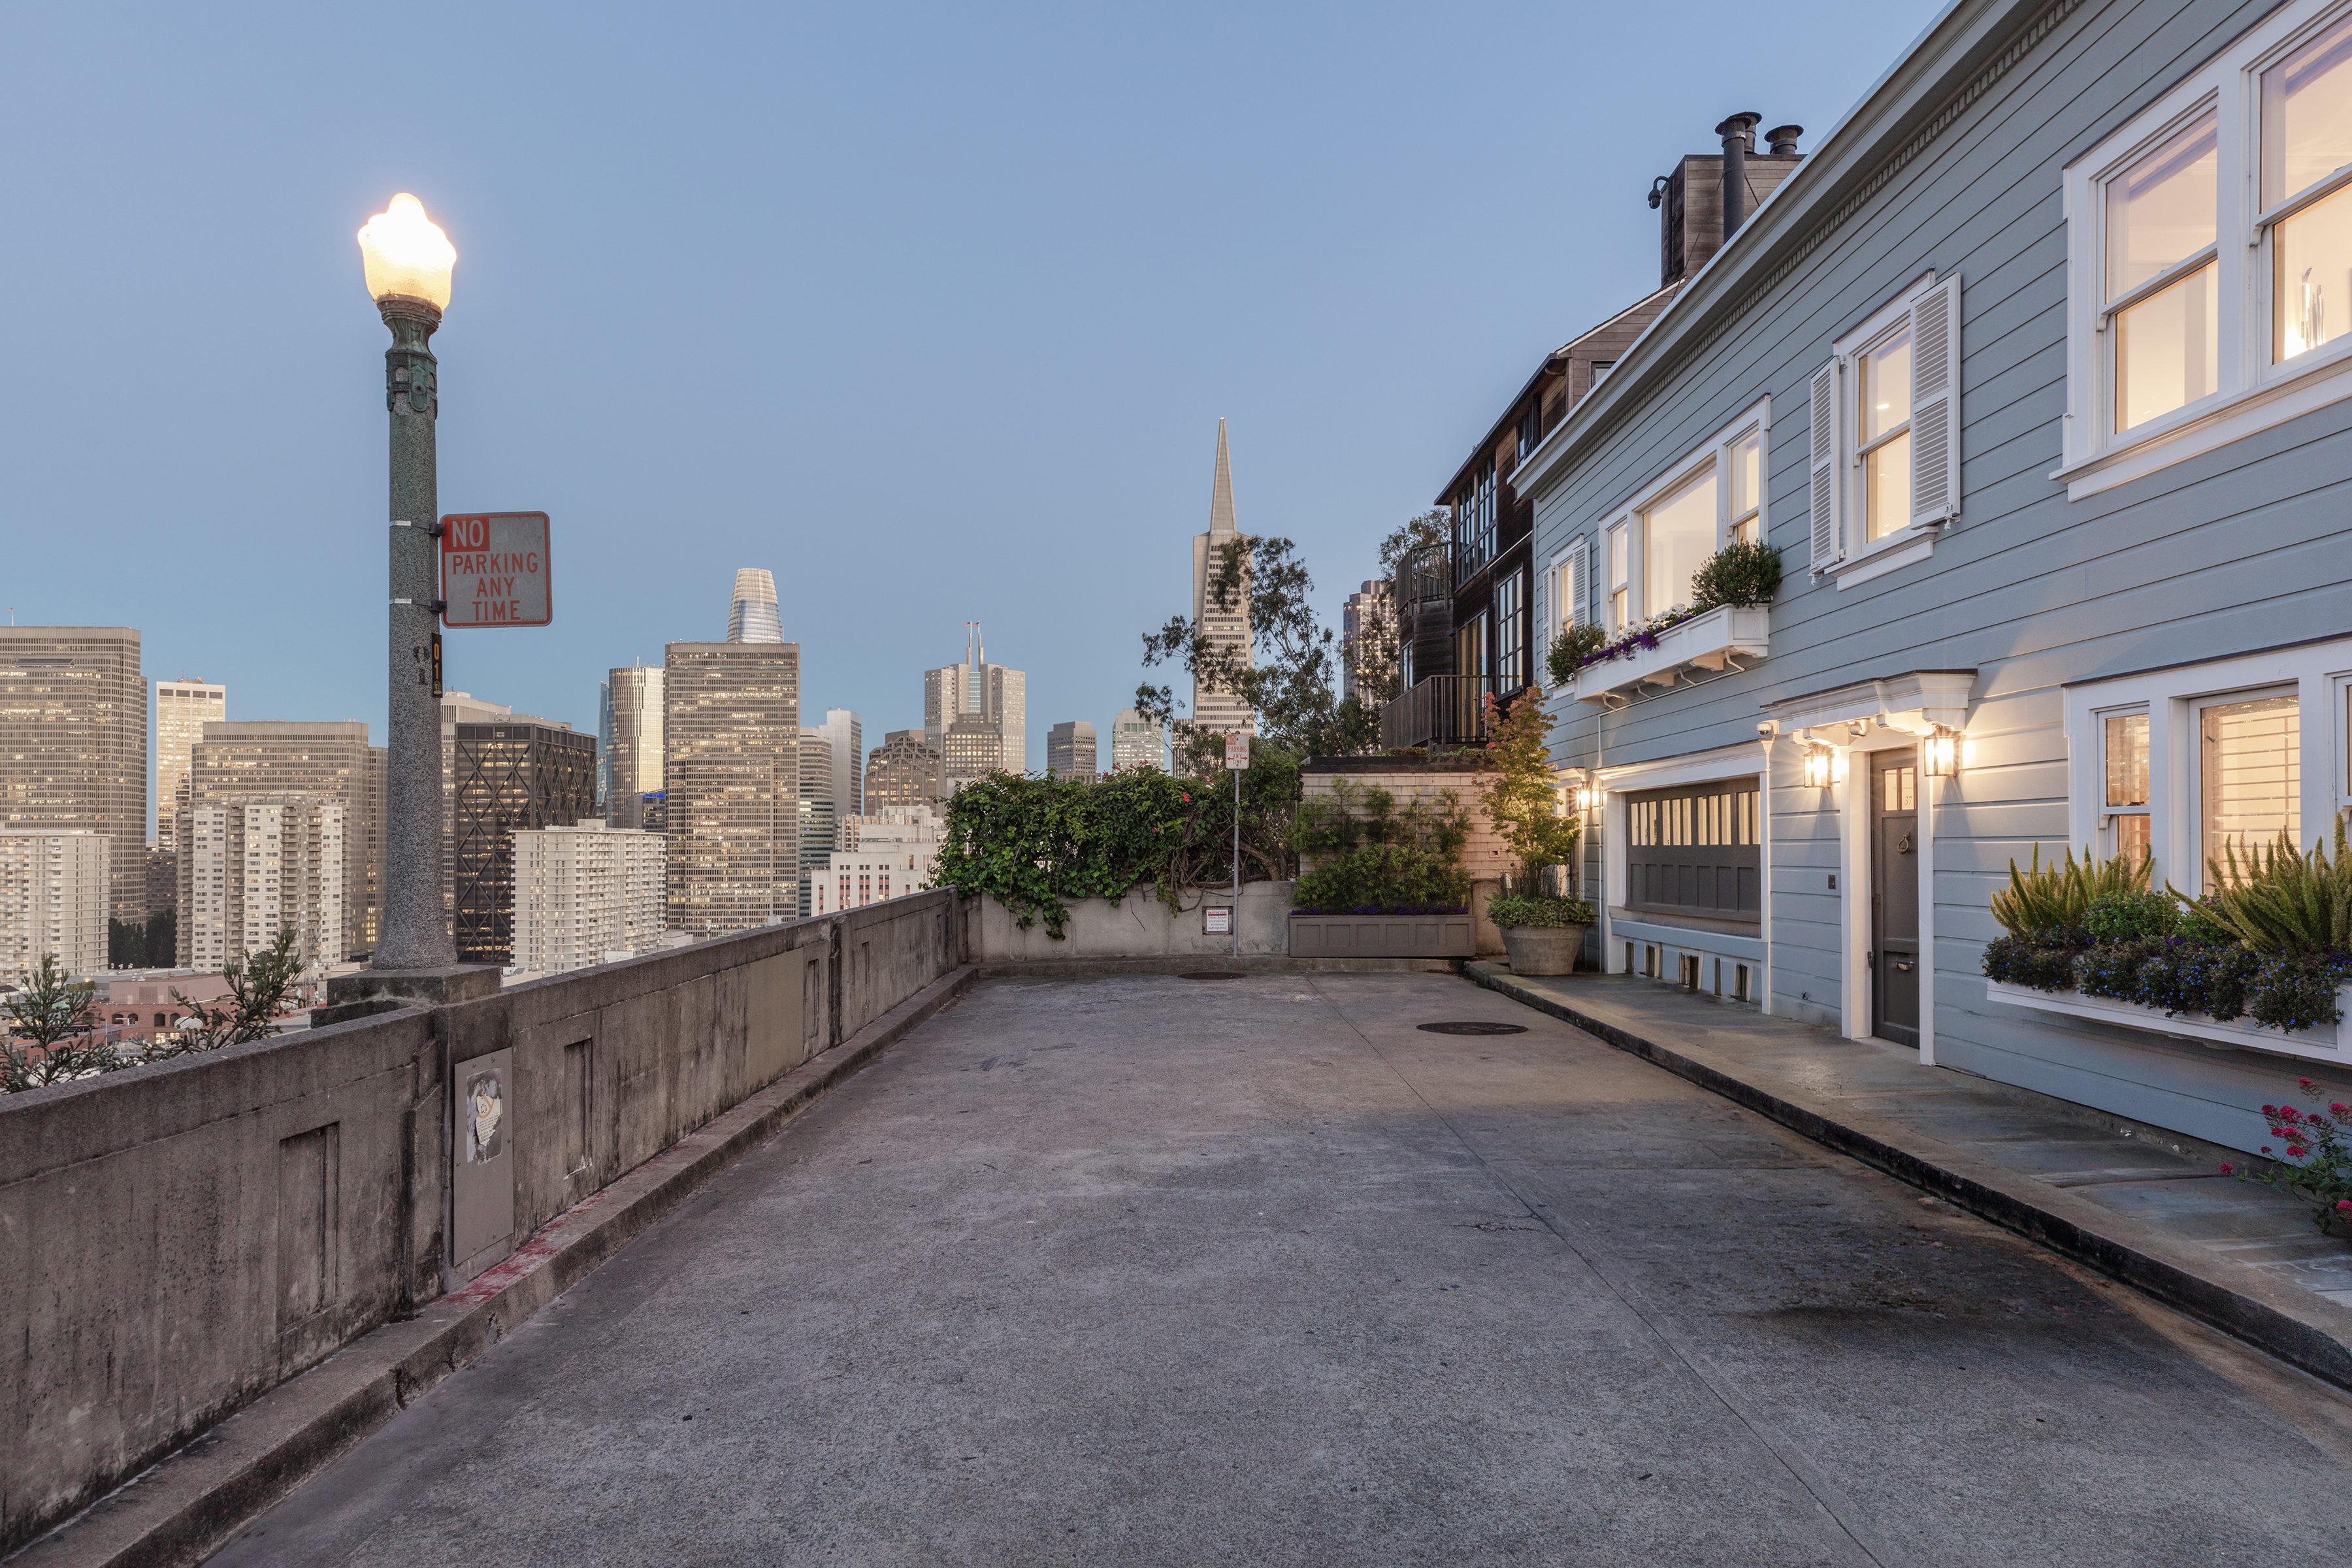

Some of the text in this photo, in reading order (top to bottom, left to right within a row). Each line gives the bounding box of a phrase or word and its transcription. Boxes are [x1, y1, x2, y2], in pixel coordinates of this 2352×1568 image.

[452, 519, 484, 547] NO
[452, 552, 538, 575] PARKING
[476, 576, 515, 598] ANY
[472, 600, 521, 621] TIME
[1904, 796, 1912, 806] 37
